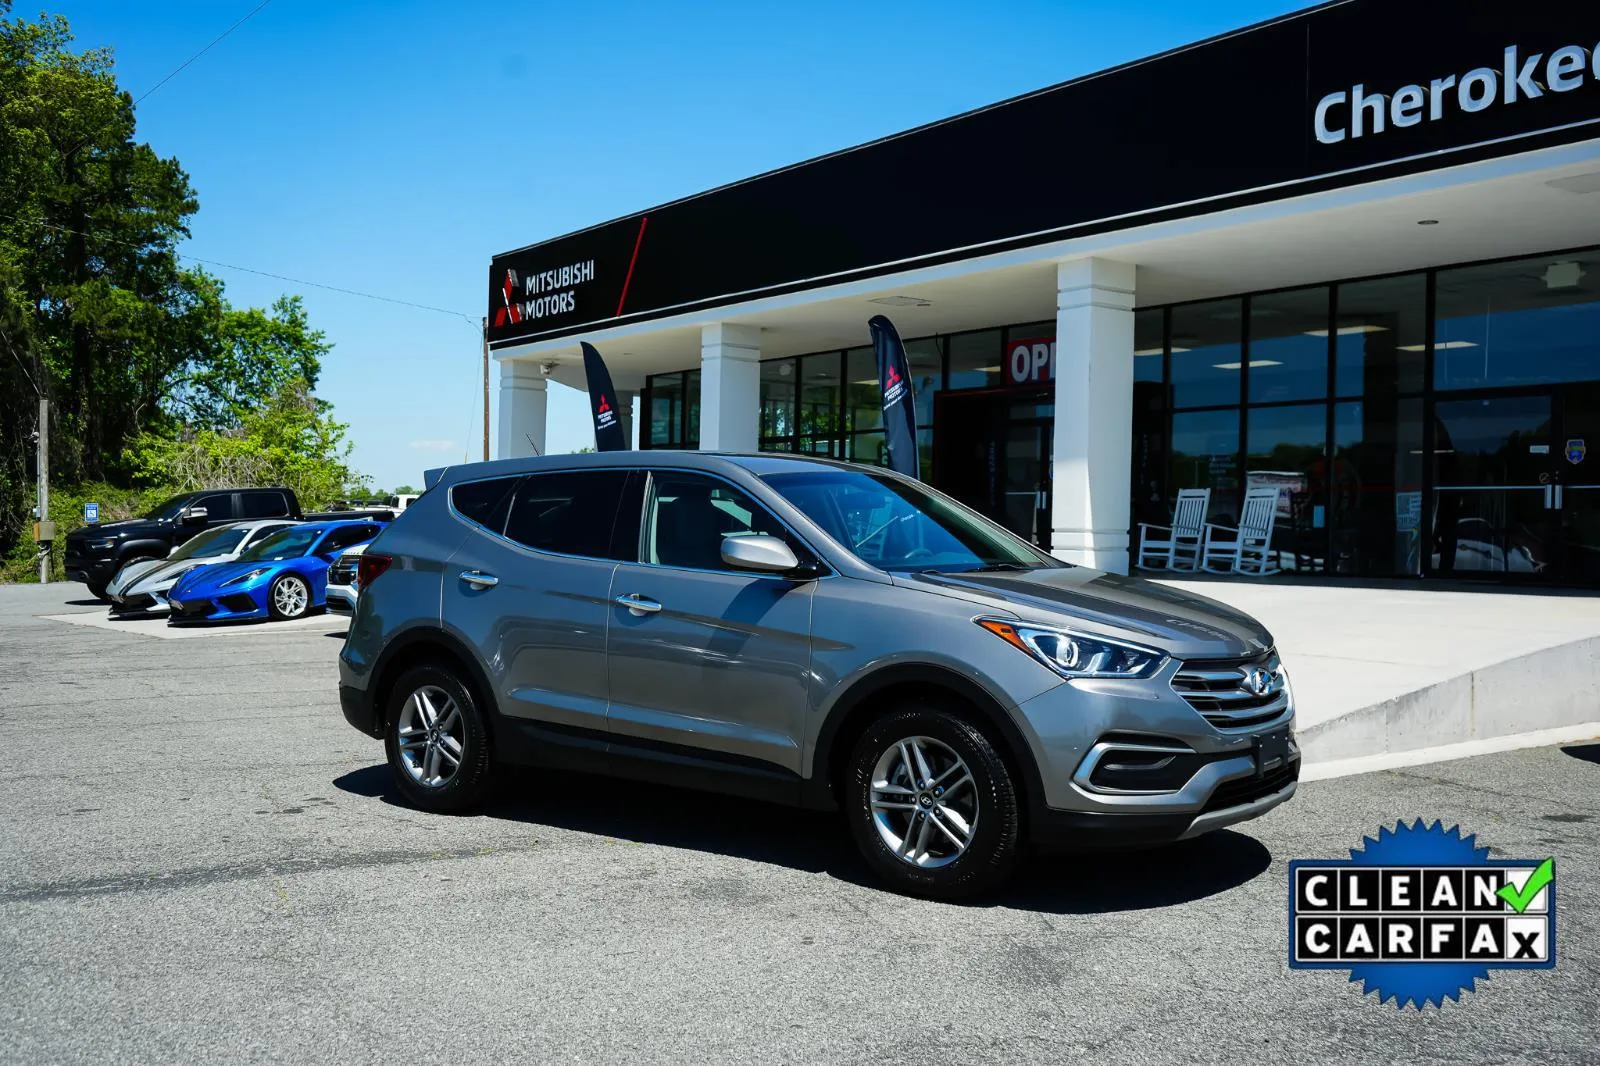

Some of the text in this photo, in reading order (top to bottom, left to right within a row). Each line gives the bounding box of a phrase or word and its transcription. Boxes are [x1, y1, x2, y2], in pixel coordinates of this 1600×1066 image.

[1314, 40, 1600, 144] Cheroke
[526, 260, 594, 295] MITSUBISHI
[525, 290, 575, 321] MOTORS
[1011, 341, 1057, 383] OP
